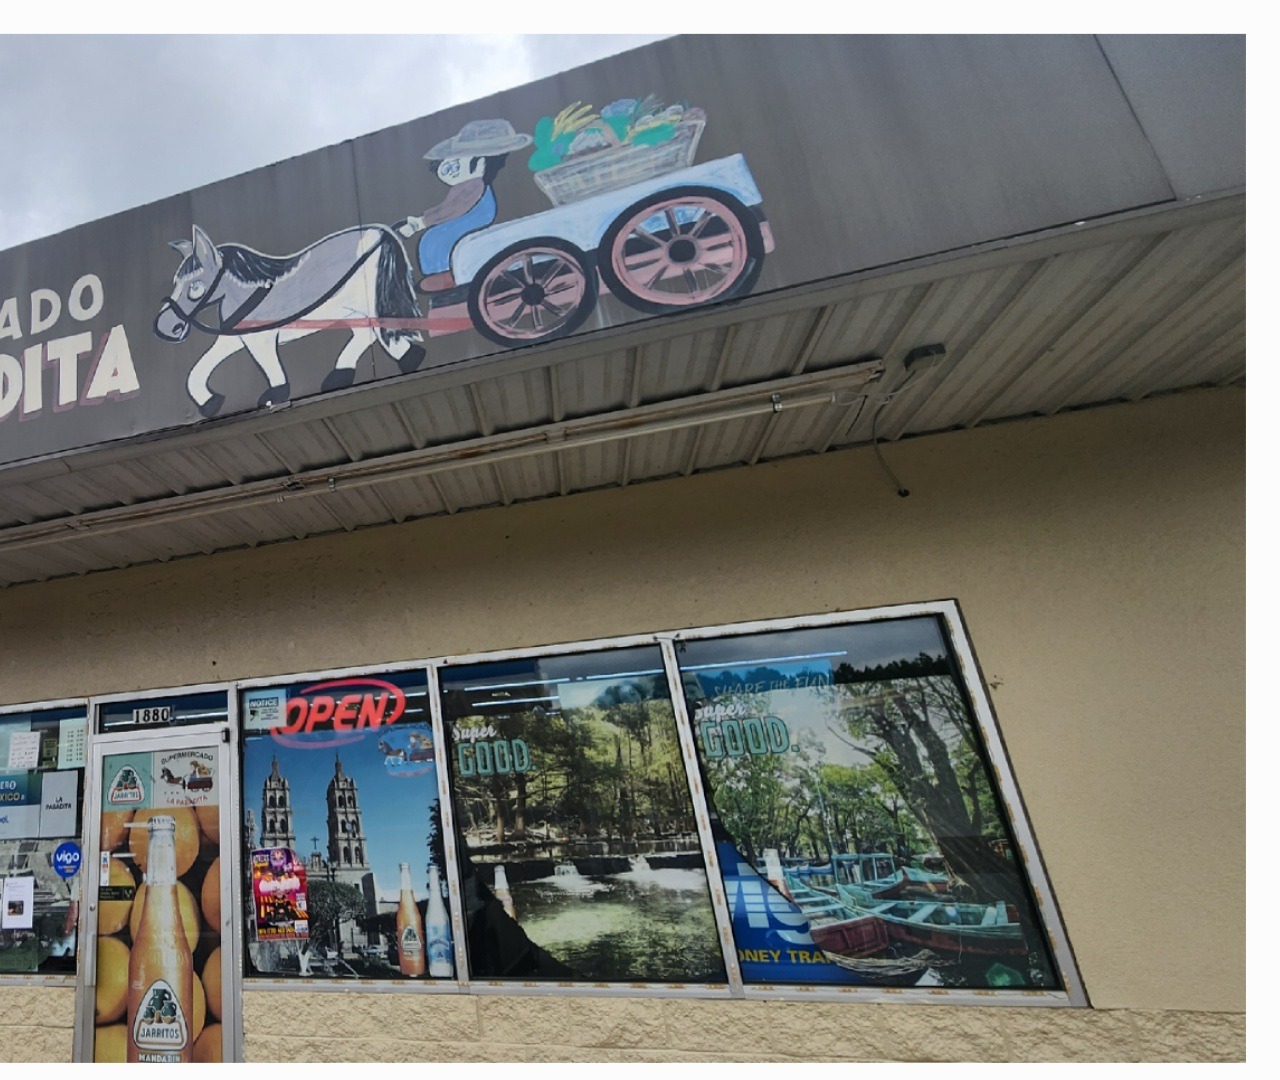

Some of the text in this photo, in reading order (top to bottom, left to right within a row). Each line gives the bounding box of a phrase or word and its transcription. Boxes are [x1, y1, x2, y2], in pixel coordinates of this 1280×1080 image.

[134, 707, 170, 724] 1880
[280, 692, 390, 734] OPEN
[160, 751, 214, 765] SUPERMERCADO
[56, 849, 80, 864] vigo
[140, 1027, 180, 1039] JARRITOS
